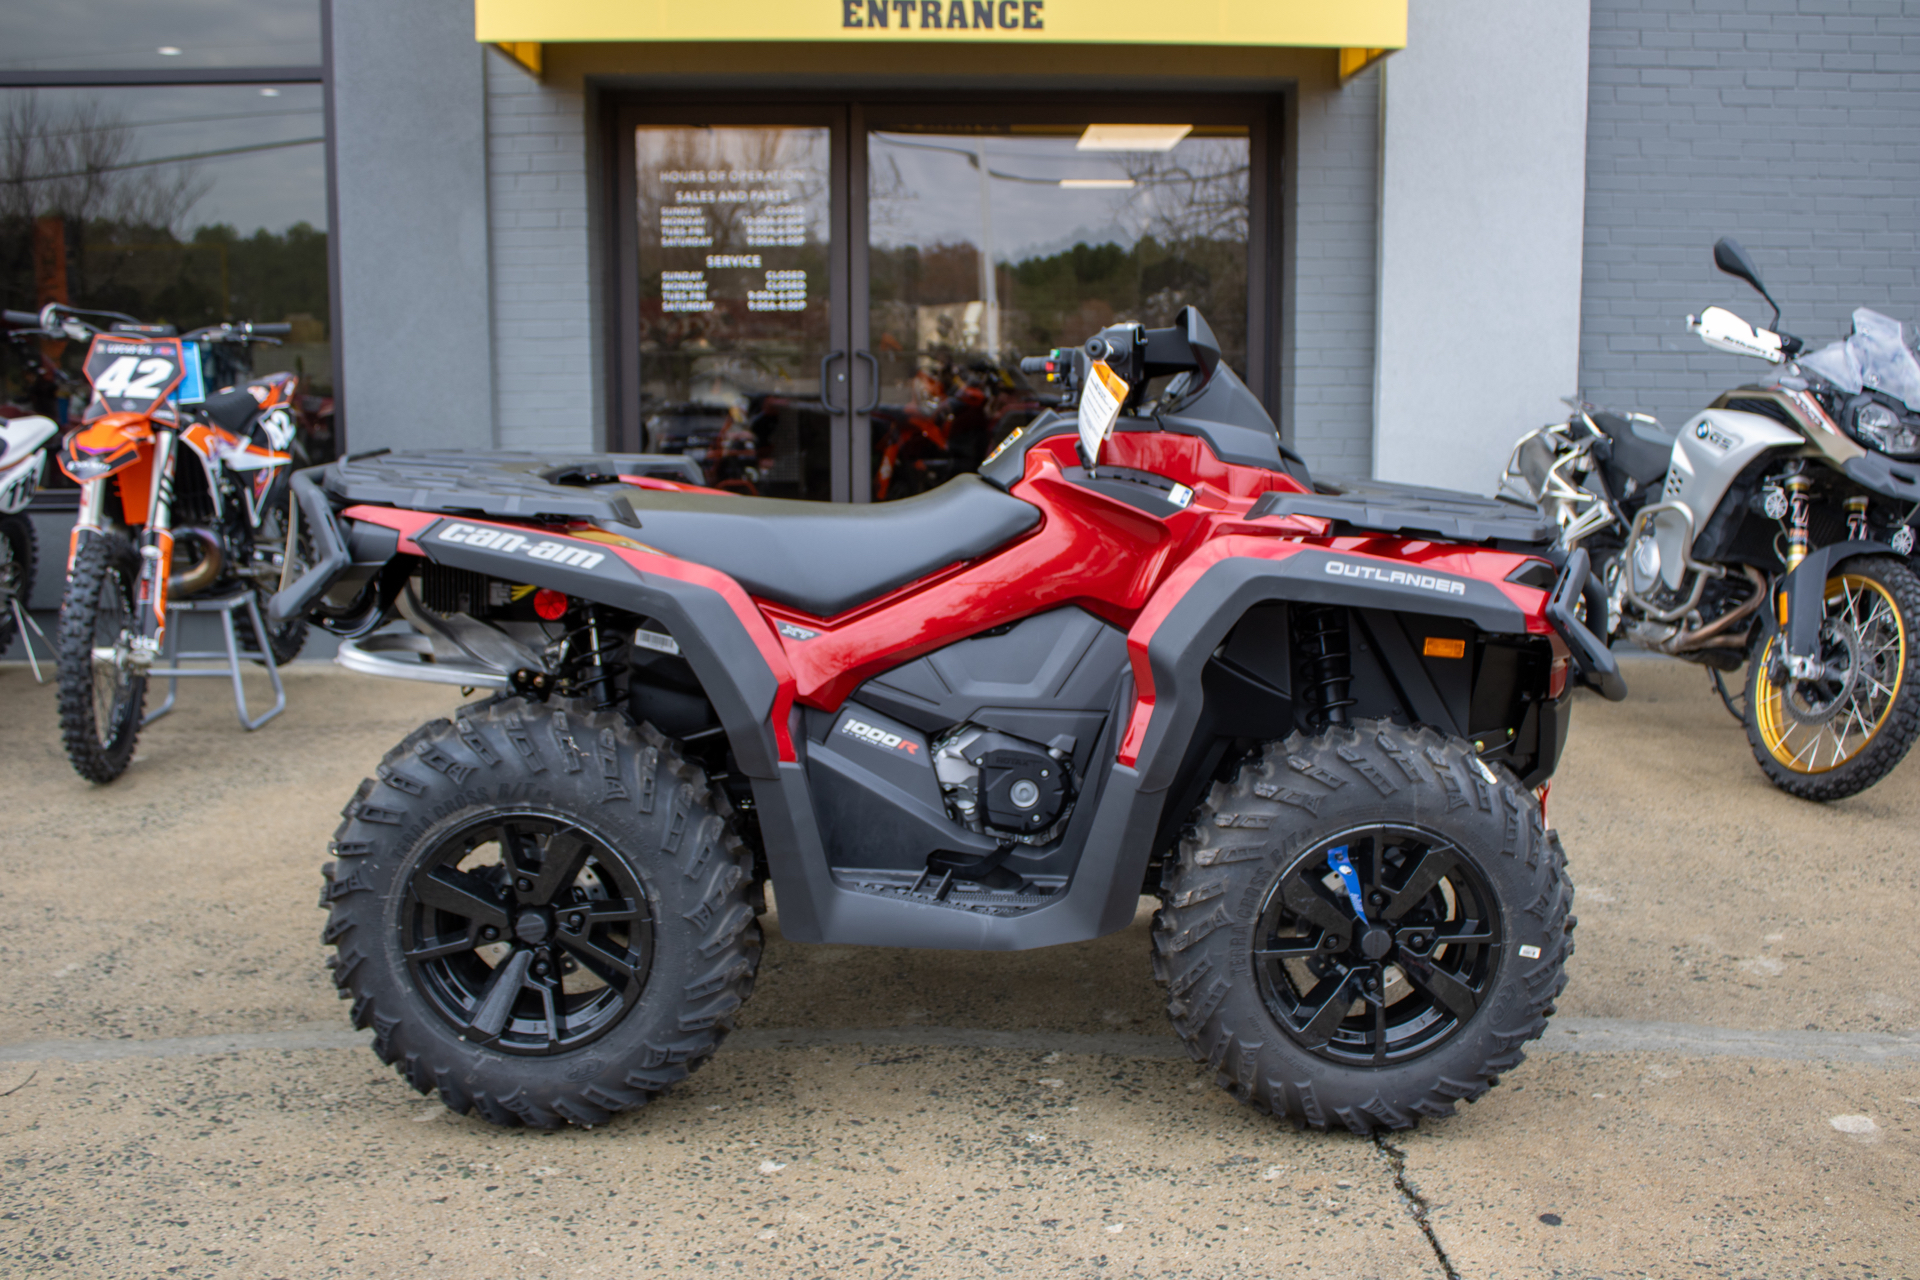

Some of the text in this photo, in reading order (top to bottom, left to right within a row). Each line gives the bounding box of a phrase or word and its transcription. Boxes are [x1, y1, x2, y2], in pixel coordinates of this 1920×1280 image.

[842, 0, 1045, 30] ENTRANCE
[659, 170, 806, 183] HOURS OF OPERATION
[675, 189, 791, 204] SALES AND PARTS
[660, 205, 806, 217] SUNDAY CLOSED
[660, 216, 707, 227] MONDAY
[660, 236, 714, 248] SATURDAY
[706, 254, 763, 268] SERVICE
[661, 270, 807, 281] SUNDAY CLOSED
[661, 280, 807, 291] MONDAY CLOSED
[662, 301, 715, 312] SATURDAY
[94, 356, 175, 400] 42
[1709, 431, 1734, 451] GS
[438, 522, 606, 570] can-am
[1324, 560, 1466, 595] OUTLANDER
[843, 717, 920, 756] 1000R
